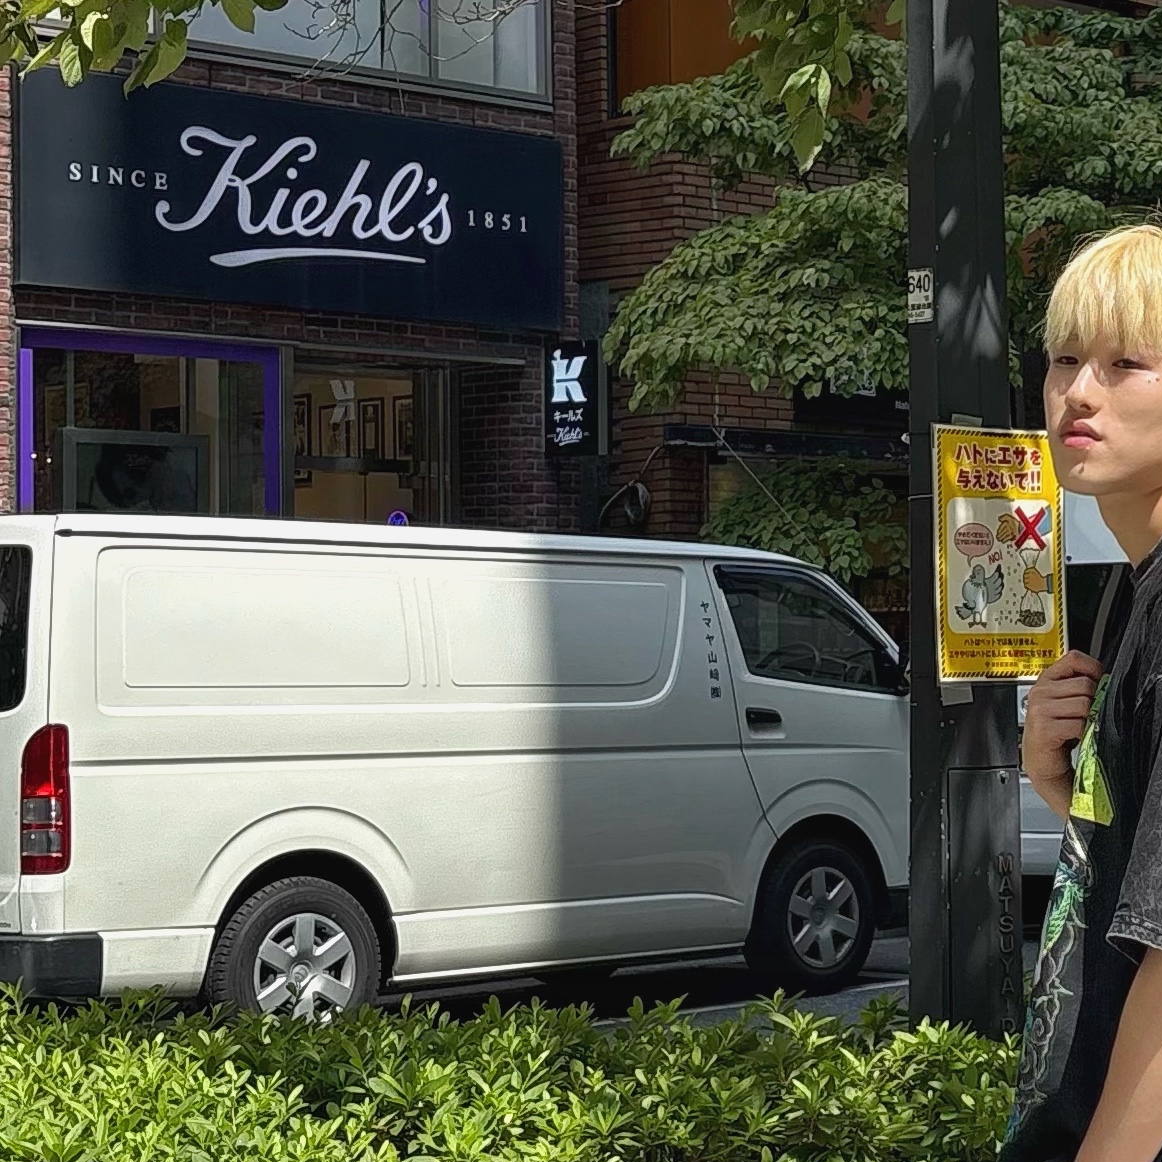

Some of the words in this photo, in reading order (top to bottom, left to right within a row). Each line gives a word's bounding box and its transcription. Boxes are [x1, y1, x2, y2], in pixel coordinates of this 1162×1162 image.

[69, 161, 169, 191] SINCE
[154, 125, 453, 246] Kiehl's
[466, 208, 529, 234] 1851
[551, 349, 588, 403] K
[553, 407, 584, 423] キールズ
[955, 443, 1042, 467] ハトにエサを
[956, 468, 1042, 492] 与えないで!!
